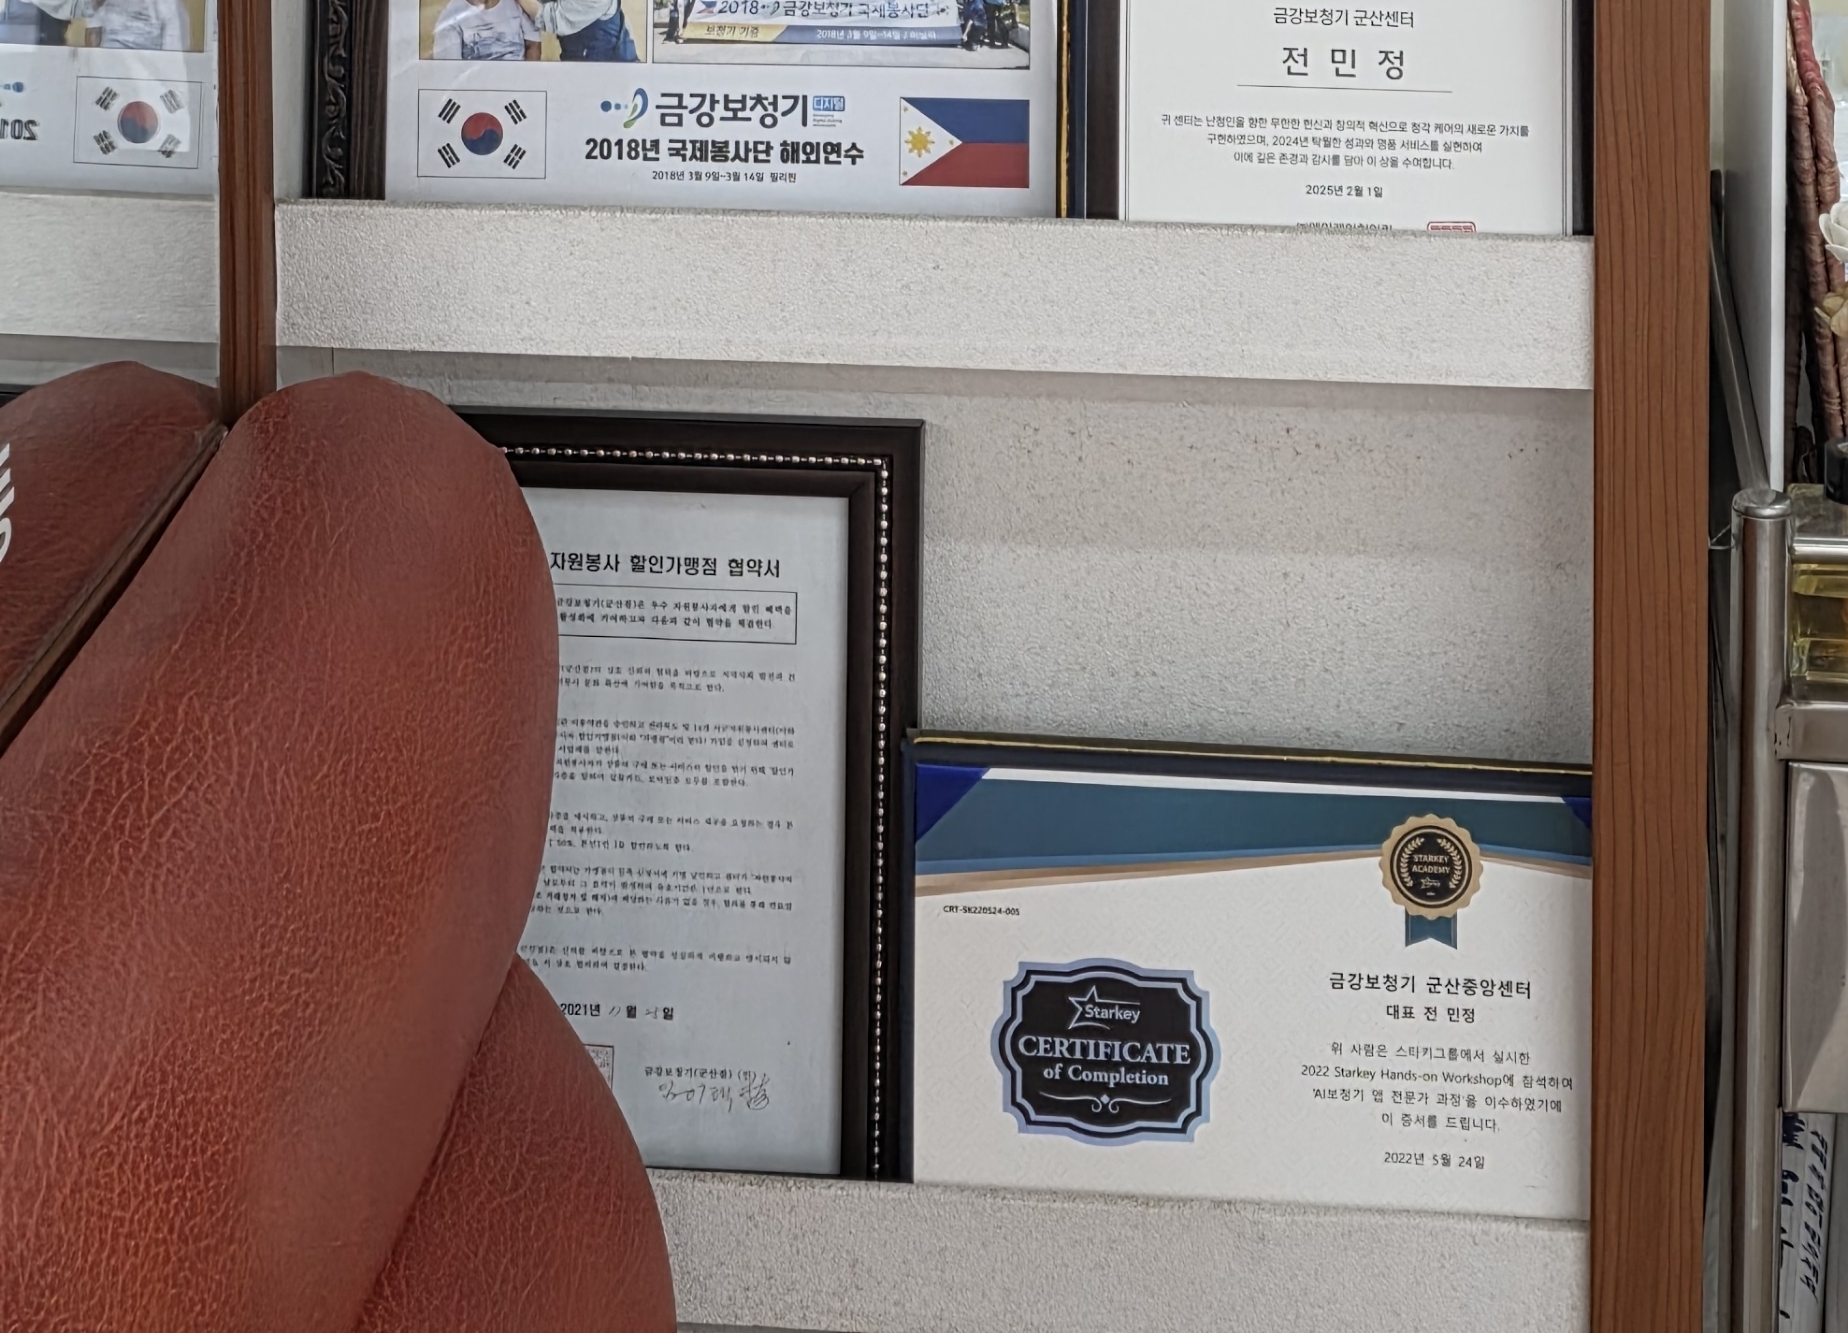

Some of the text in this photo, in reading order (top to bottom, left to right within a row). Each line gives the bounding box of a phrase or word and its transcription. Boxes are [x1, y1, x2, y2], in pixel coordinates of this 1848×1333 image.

[717, 0, 759, 14] 2018
[782, 0, 854, 19] 금강보청기
[1274, 8, 1413, 28] 금강보청기 군산센터
[655, 93, 807, 129] 금강보청기
[1272, 135, 1308, 147] 2024년
[585, 138, 864, 165] 2018년 국제봉사단 해외연수
[653, 171, 684, 181] 2018년
[1306, 185, 1363, 197] 2025년 2월
[550, 552, 779, 578] 자원봉사 할인가맹점 협약서
[1413, 854, 1449, 863] STARKEY
[1412, 865, 1450, 873] ACADEMY
[1330, 972, 1530, 999] 금강보청기 군산중앙센터
[560, 1003, 600, 1016] 2021년
[1085, 1004, 1140, 1023] Starkey
[1387, 1005, 1415, 1019] 대표
[1018, 1035, 1191, 1065] CERTIFICATE
[1332, 1042, 1530, 1065] 위 사람은 스타키그룹에서 실시한
[1043, 1063, 1168, 1087] of Completion
[1301, 1065, 1572, 1090] 2022 Starkey Hands-on Workshop에 참석하여
[1392, 1091, 1561, 1113] 전문가 이수하였기에
[1401, 1113, 1500, 1132] 증서를 드립니다.
[1384, 1152, 1484, 1169] 2022년 5월 24일
